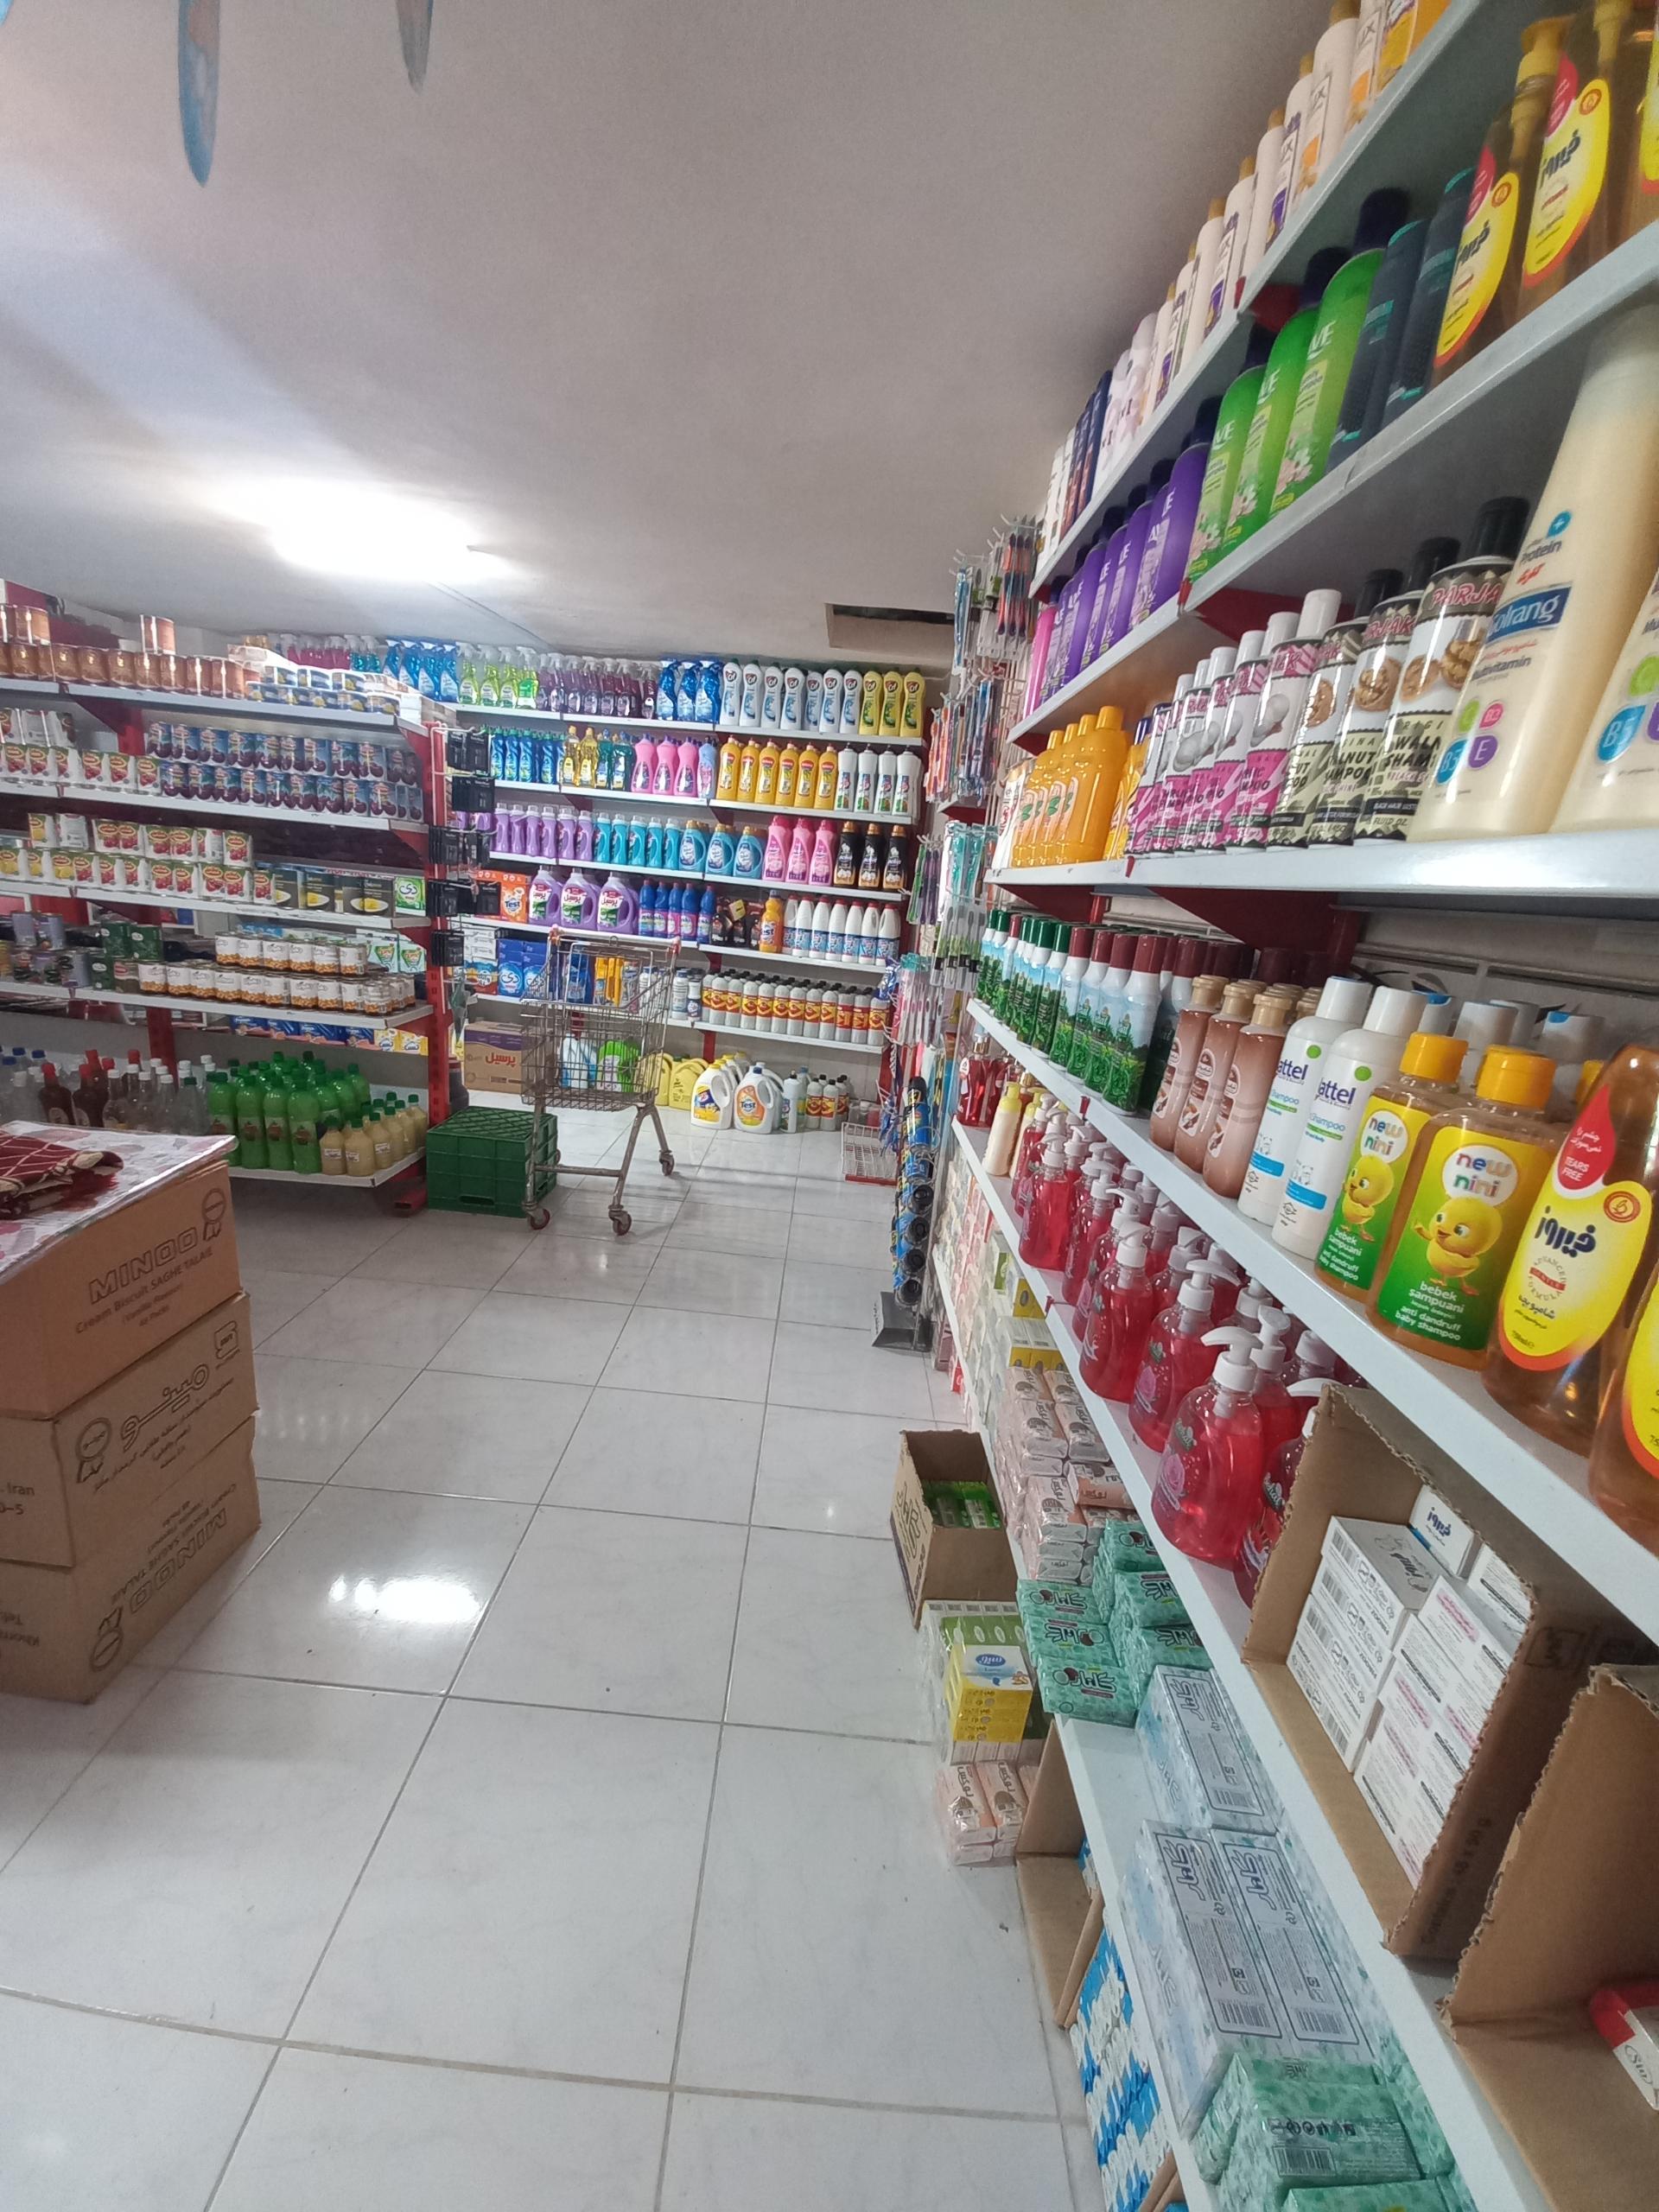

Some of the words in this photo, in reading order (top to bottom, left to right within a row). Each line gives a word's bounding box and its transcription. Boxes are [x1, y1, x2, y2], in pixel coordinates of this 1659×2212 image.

[1433, 582, 1502, 607] PARJA
[1474, 739, 1491, 761] E
[485, 1052, 517, 1068] پرسیل
[1277, 1058, 1309, 1081] attel
[1368, 1116, 1404, 1139] new
[1364, 1135, 1395, 1156] nini
[1456, 1152, 1511, 1178] new
[1560, 1166, 1584, 1182] FREE
[1564, 1156, 1590, 1173] TEARS
[1452, 1173, 1501, 1198] nini
[1534, 1205, 1597, 1258] فیروز
[89, 1226, 198, 1306] MINOO
[150, 1266, 182, 1291] SAGHE
[1420, 1281, 1458, 1301] bebek
[1395, 1310, 1416, 1326] baby
[1417, 1321, 1461, 1341] shampoo
[1401, 1306, 1418, 1317] anti
[1419, 1313, 1462, 1332] dandruff
[6, 1482, 35, 1496] Iran
[1427, 1506, 1452, 1537] فیروز
[129, 1507, 227, 1615] MINOO
[1160, 1840, 1206, 1901] گلنار
[1231, 1849, 1278, 1911] گلنار
